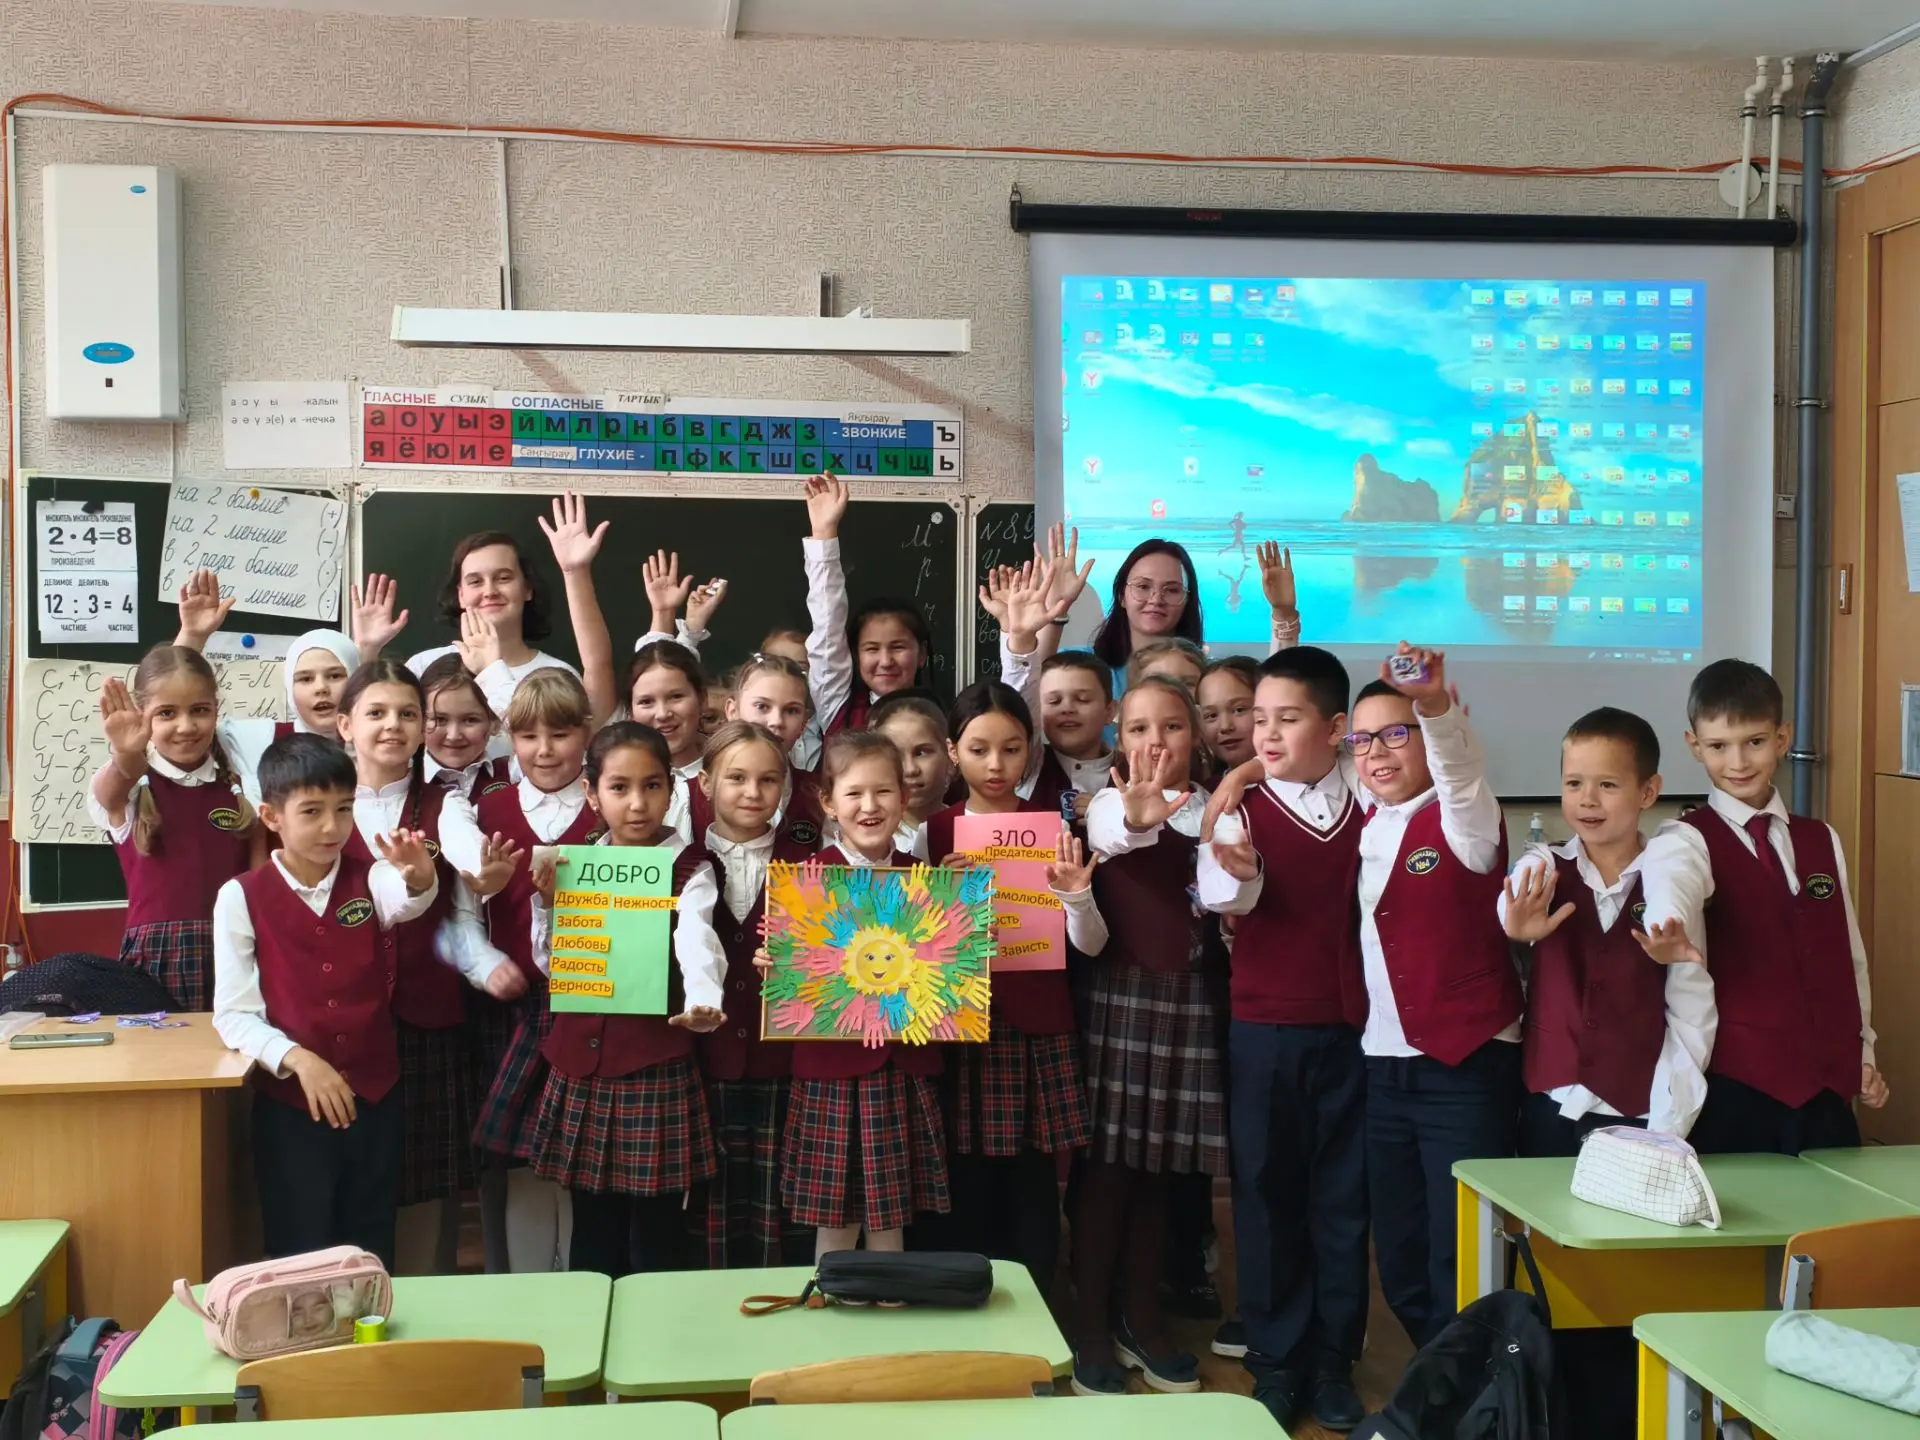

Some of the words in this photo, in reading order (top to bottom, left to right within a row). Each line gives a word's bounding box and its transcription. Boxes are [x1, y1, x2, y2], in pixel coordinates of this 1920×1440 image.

[364, 392, 436, 404] ГЛАСНЫЕ
[450, 394, 488, 403] СУЗЫК
[511, 396, 604, 410] СОГЛАСНЫЕ
[618, 394, 661, 404] ТАРТЫК
[370, 409, 385, 426] а
[401, 411, 417, 427] о
[429, 412, 446, 433] у
[458, 414, 478, 429] ы
[489, 414, 505, 430] э
[519, 413, 535, 432] й
[606, 418, 621, 438] р
[663, 417, 677, 436] б
[842, 427, 907, 439] ЗВОНКИЕ
[370, 440, 384, 457] я
[399, 436, 415, 457] ё
[427, 443, 449, 459] ю
[460, 444, 476, 459] и
[489, 444, 505, 461] е
[579, 448, 635, 460] ГЛУХИЕ
[174, 485, 199, 502] на
[207, 486, 222, 505] 2
[169, 514, 195, 533] на
[203, 514, 218, 536] 2
[224, 523, 287, 544] меньше
[164, 538, 177, 562] в
[183, 541, 200, 566] 2
[245, 546, 299, 578] больше
[162, 568, 175, 592] в
[244, 588, 306, 609] меньше
[44, 594, 63, 614] 12
[992, 830, 1036, 848] ЗЛО
[577, 863, 660, 886] ДОБРО
[556, 892, 609, 909] Дружба
[614, 897, 678, 909] Нежность
[994, 890, 1060, 907] амолюбие
[557, 915, 603, 928] Забота
[554, 936, 607, 950] Любовь
[1001, 941, 1050, 958] Зависть
[552, 957, 605, 973] Радость
[550, 979, 612, 993] Верность
